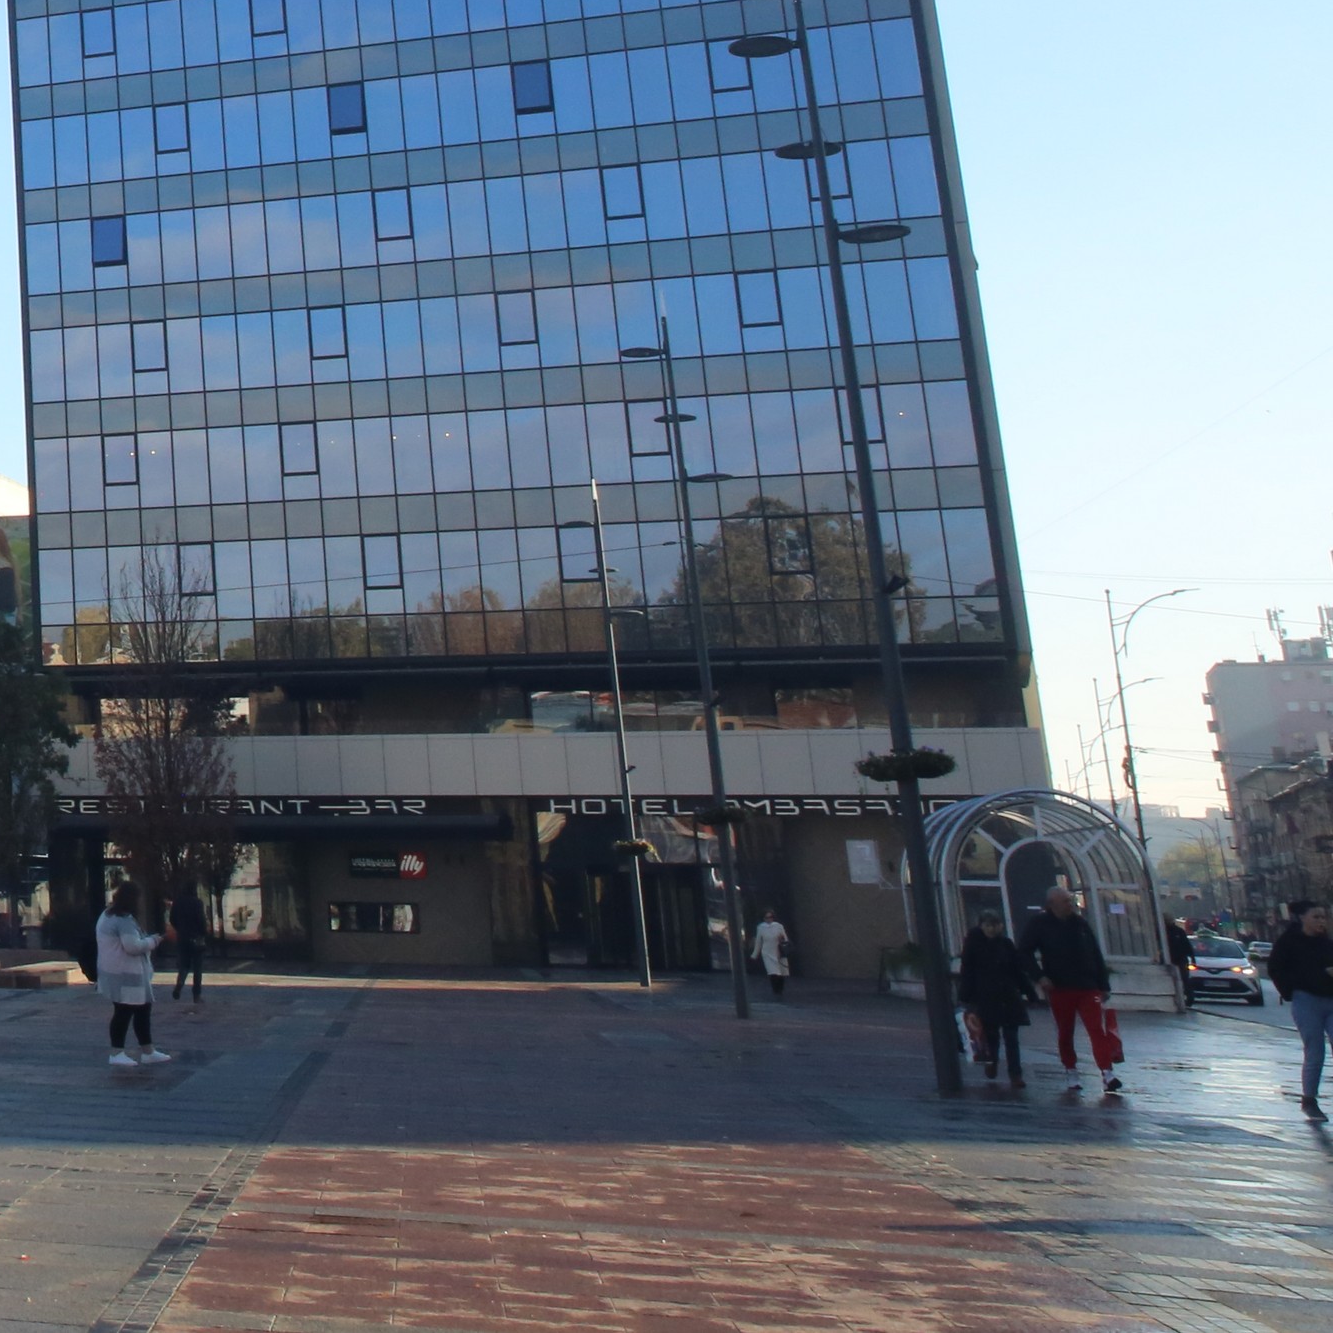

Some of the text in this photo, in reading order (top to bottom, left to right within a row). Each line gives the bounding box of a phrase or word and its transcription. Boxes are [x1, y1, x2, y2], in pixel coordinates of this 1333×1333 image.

[54, 799, 310, 815] RESURANT
[549, 798, 695, 816] HOTEL
[400, 854, 425, 876] illy
